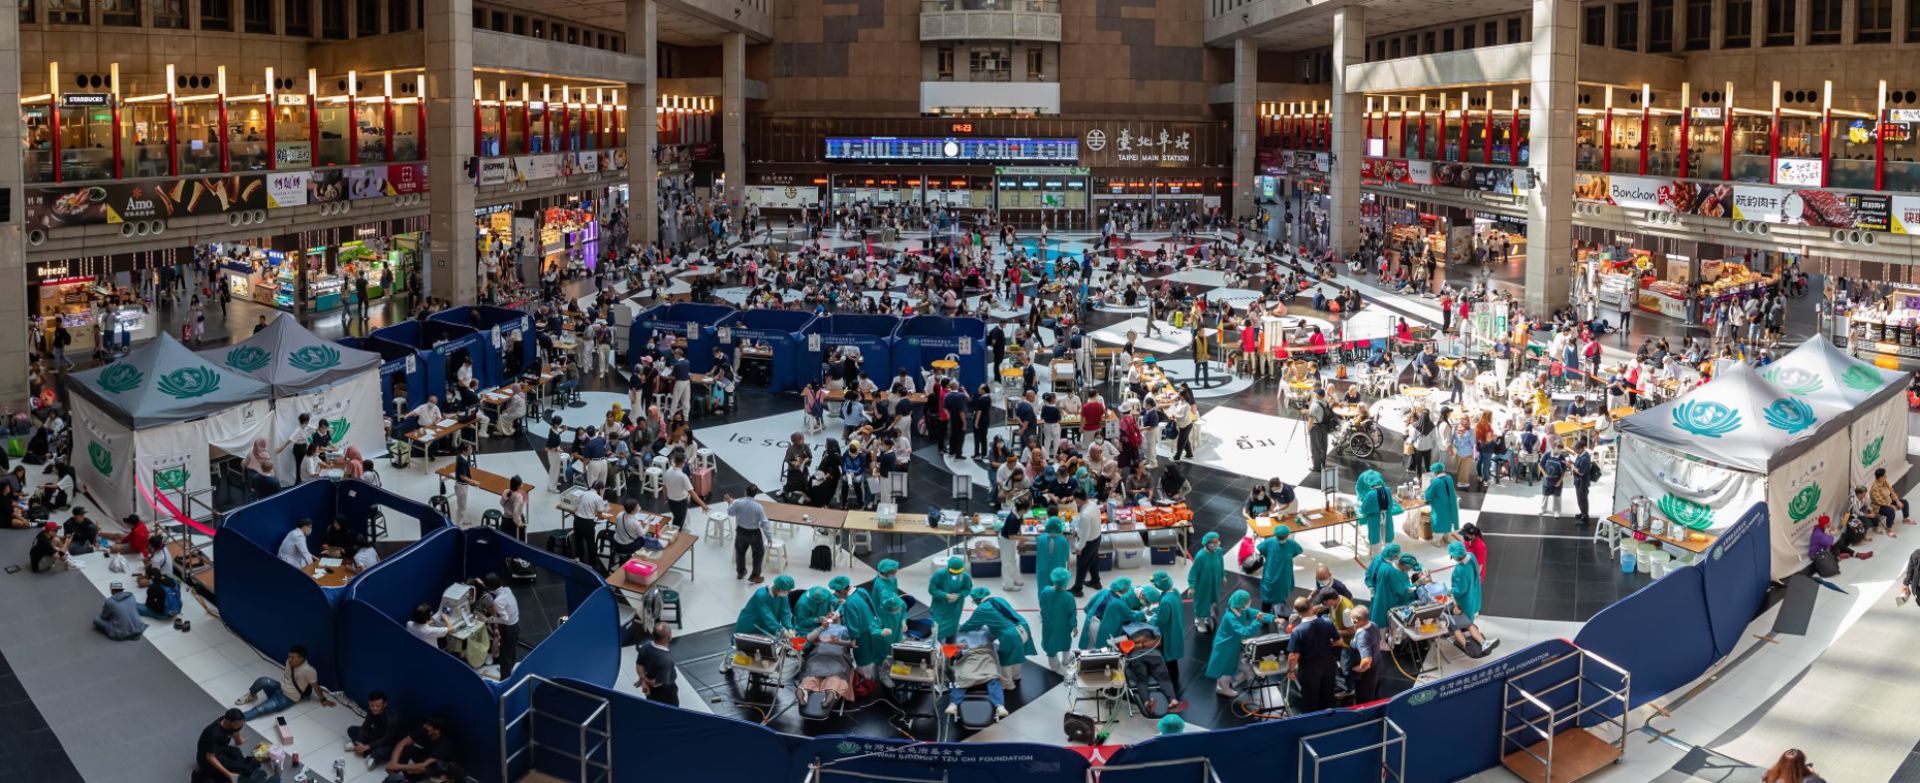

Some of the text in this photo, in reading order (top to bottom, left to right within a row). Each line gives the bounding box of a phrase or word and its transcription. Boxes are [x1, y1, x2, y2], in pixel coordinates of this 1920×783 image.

[1117, 128, 1190, 153] 臺北車站
[1163, 154, 1190, 162] STATION
[1612, 184, 1657, 201] Bonchon
[126, 197, 153, 211] Amo
[38, 266, 68, 277] Breeze
[729, 432, 753, 445] le
[1439, 686, 1462, 698] TAIWAN
